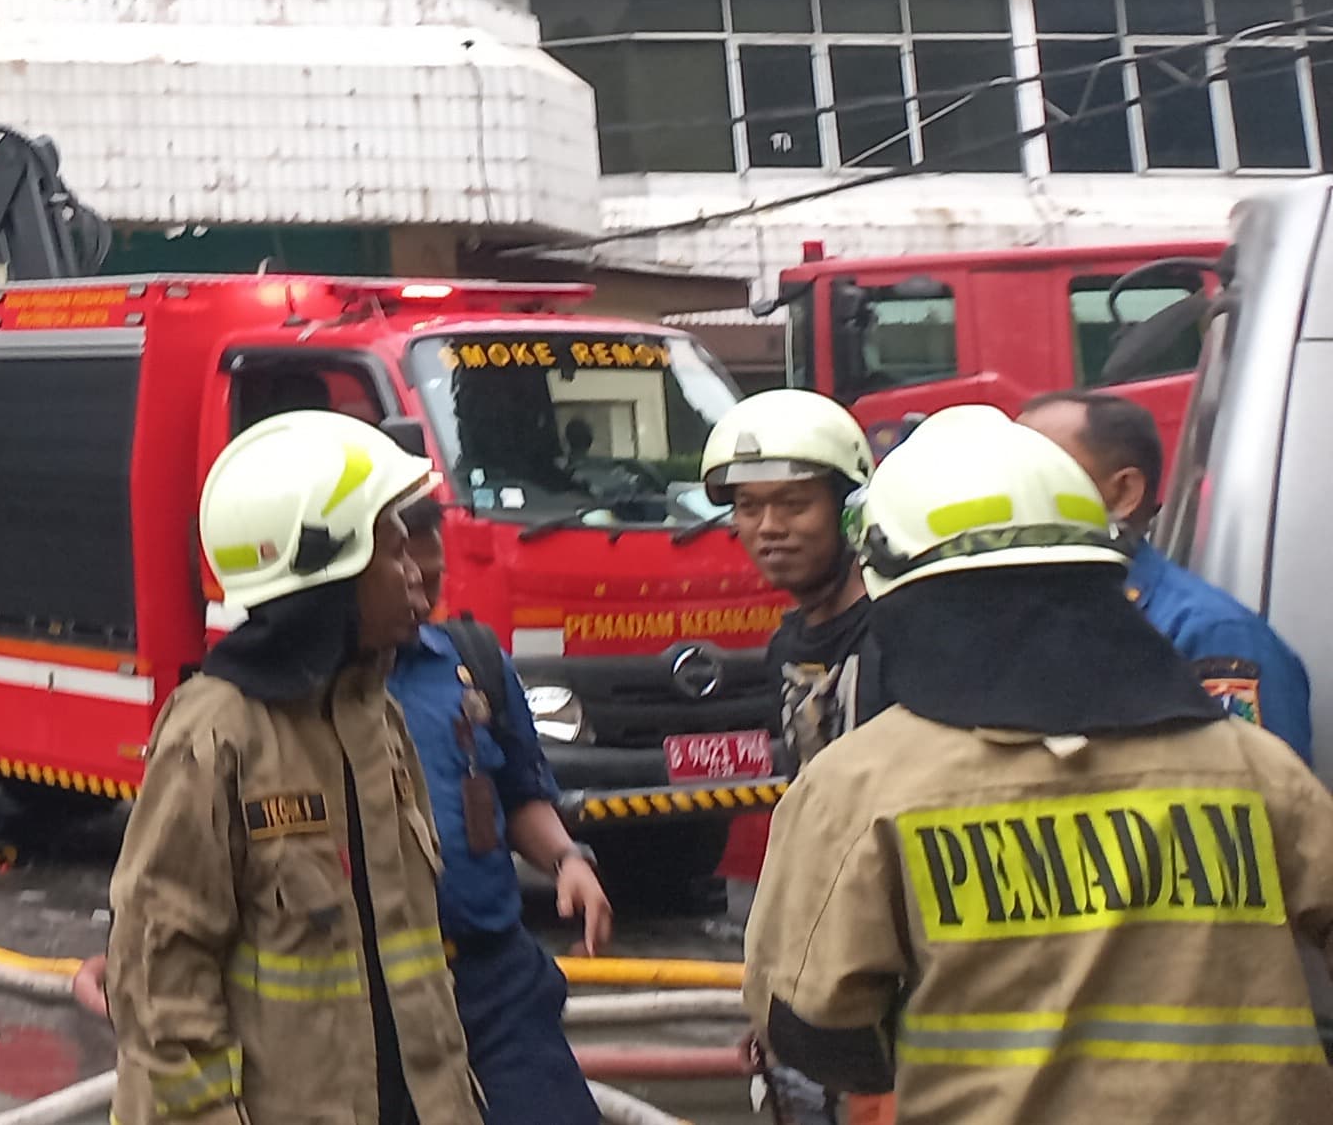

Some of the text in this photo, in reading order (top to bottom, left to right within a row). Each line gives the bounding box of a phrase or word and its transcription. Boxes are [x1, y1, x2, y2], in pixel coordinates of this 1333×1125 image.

[438, 341, 556, 369] SMOKE
[564, 604, 785, 642] PEMADAM KEBAKARA
[915, 803, 1267, 926] PEMADAM
